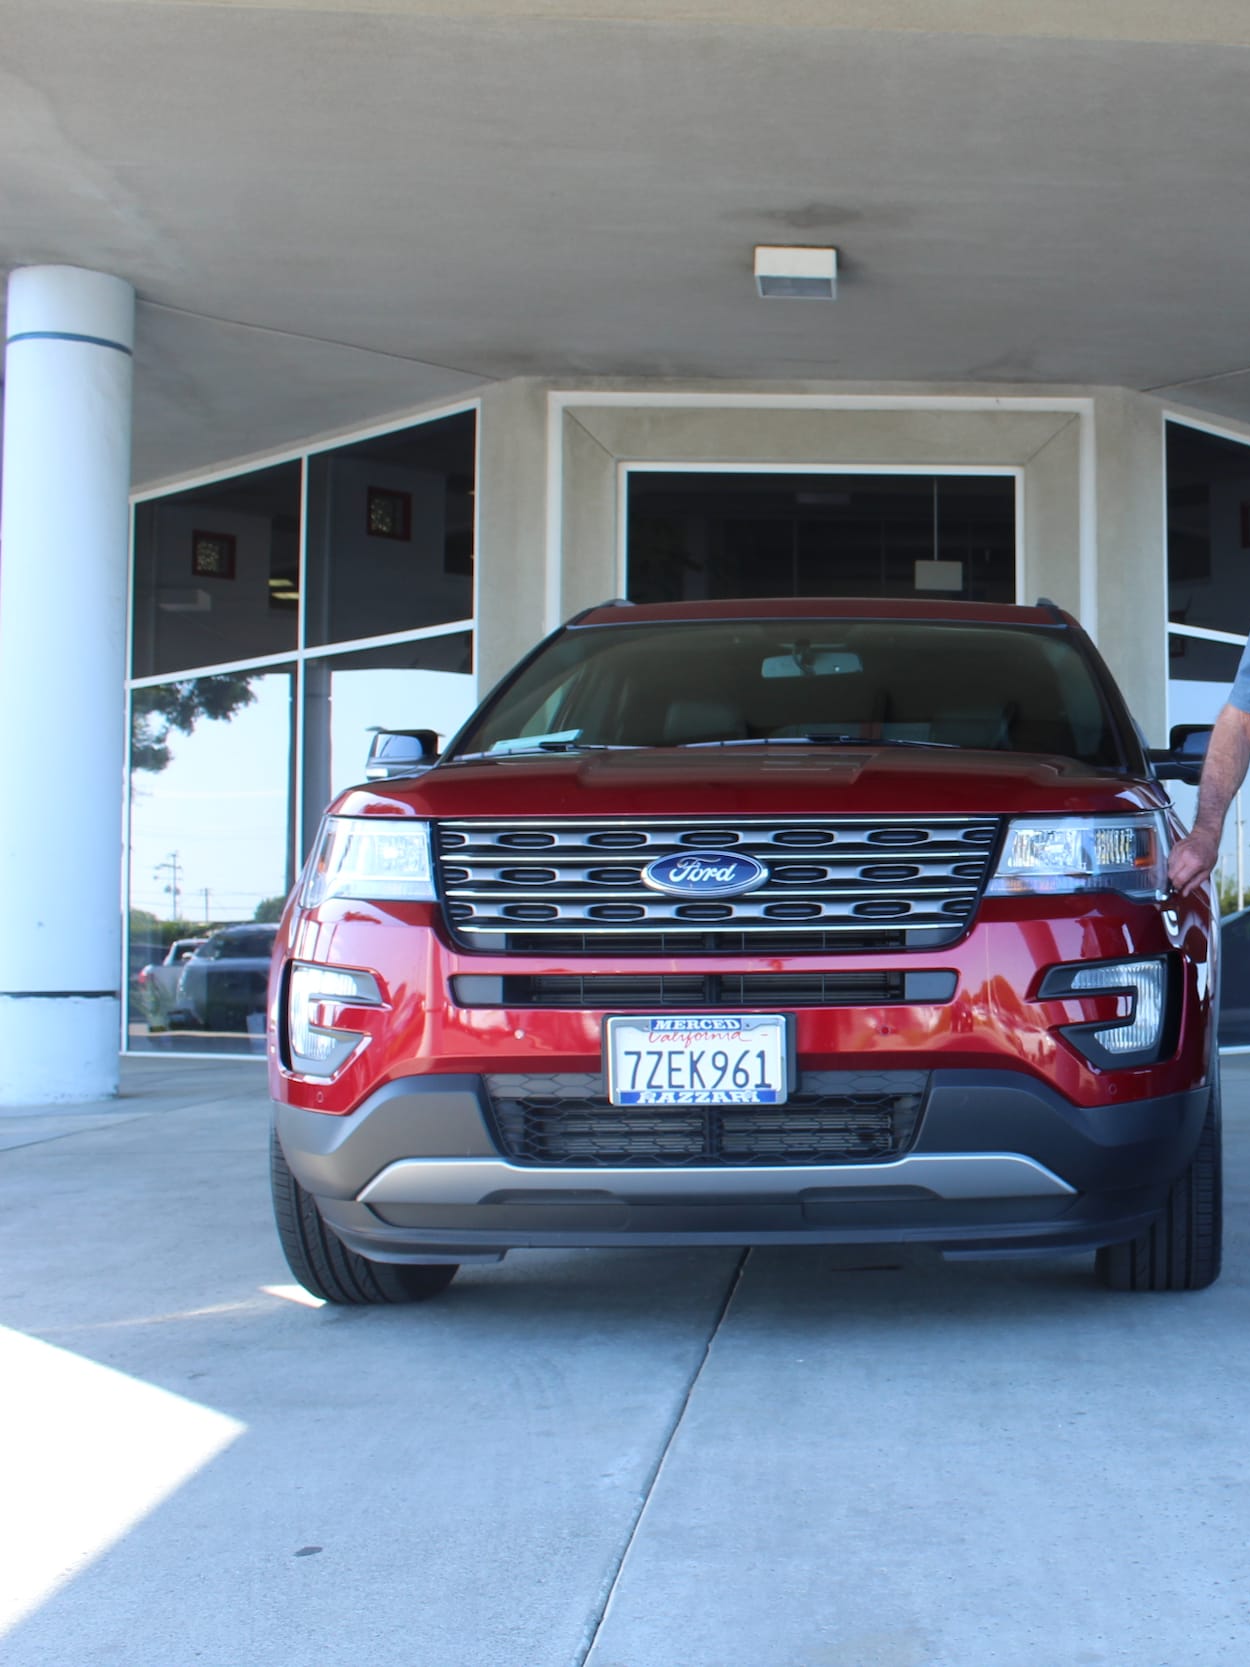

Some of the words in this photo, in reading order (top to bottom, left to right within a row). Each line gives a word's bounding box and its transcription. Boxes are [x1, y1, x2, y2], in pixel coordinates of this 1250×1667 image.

[669, 857, 738, 882] Ford
[653, 1018, 741, 1031] MERCED
[623, 1049, 772, 1090] 7ZEK961
[637, 1090, 760, 1104] RAZZARI
